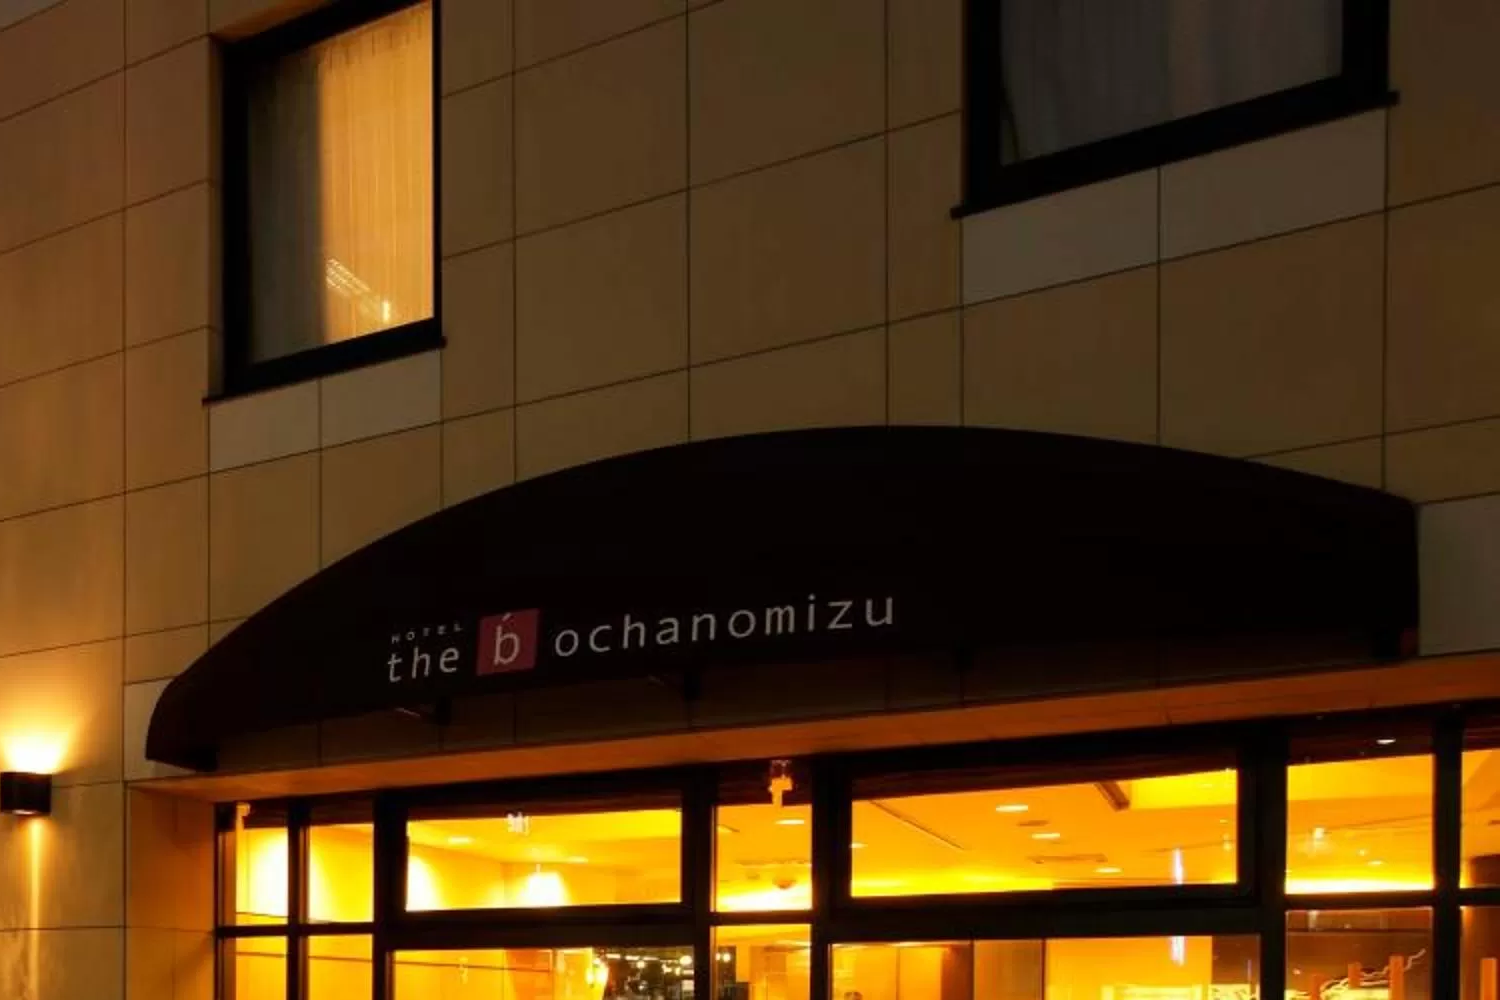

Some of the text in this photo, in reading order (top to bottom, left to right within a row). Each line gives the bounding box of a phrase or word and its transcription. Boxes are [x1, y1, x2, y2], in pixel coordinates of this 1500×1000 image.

[387, 644, 461, 684] the
[554, 593, 896, 658] ochanomizu
[390, 620, 464, 645] HOTEL
